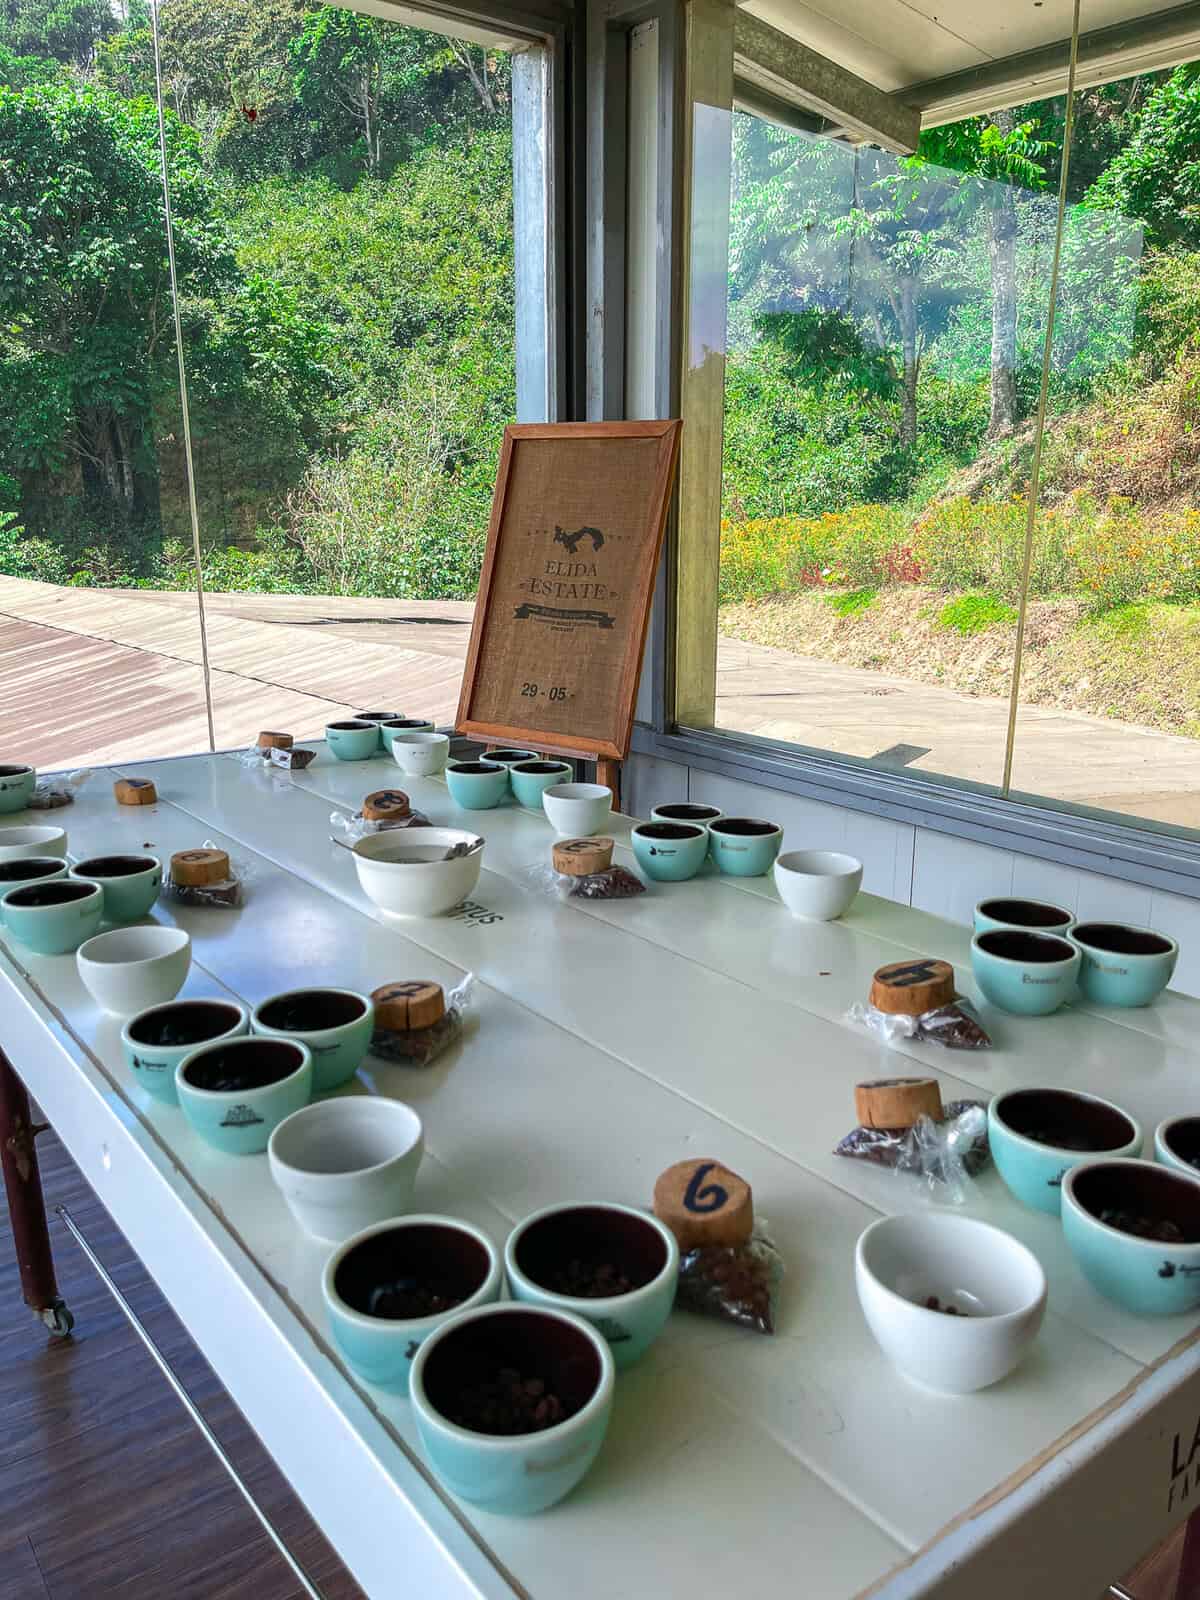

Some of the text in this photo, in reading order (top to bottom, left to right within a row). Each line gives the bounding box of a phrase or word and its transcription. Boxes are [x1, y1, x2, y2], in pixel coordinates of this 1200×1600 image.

[544, 560, 598, 577] ELIDA
[527, 577, 607, 600] ESTATE
[521, 682, 538, 697] 29
[548, 687, 567, 701] 05
[684, 1164, 728, 1214] 6
